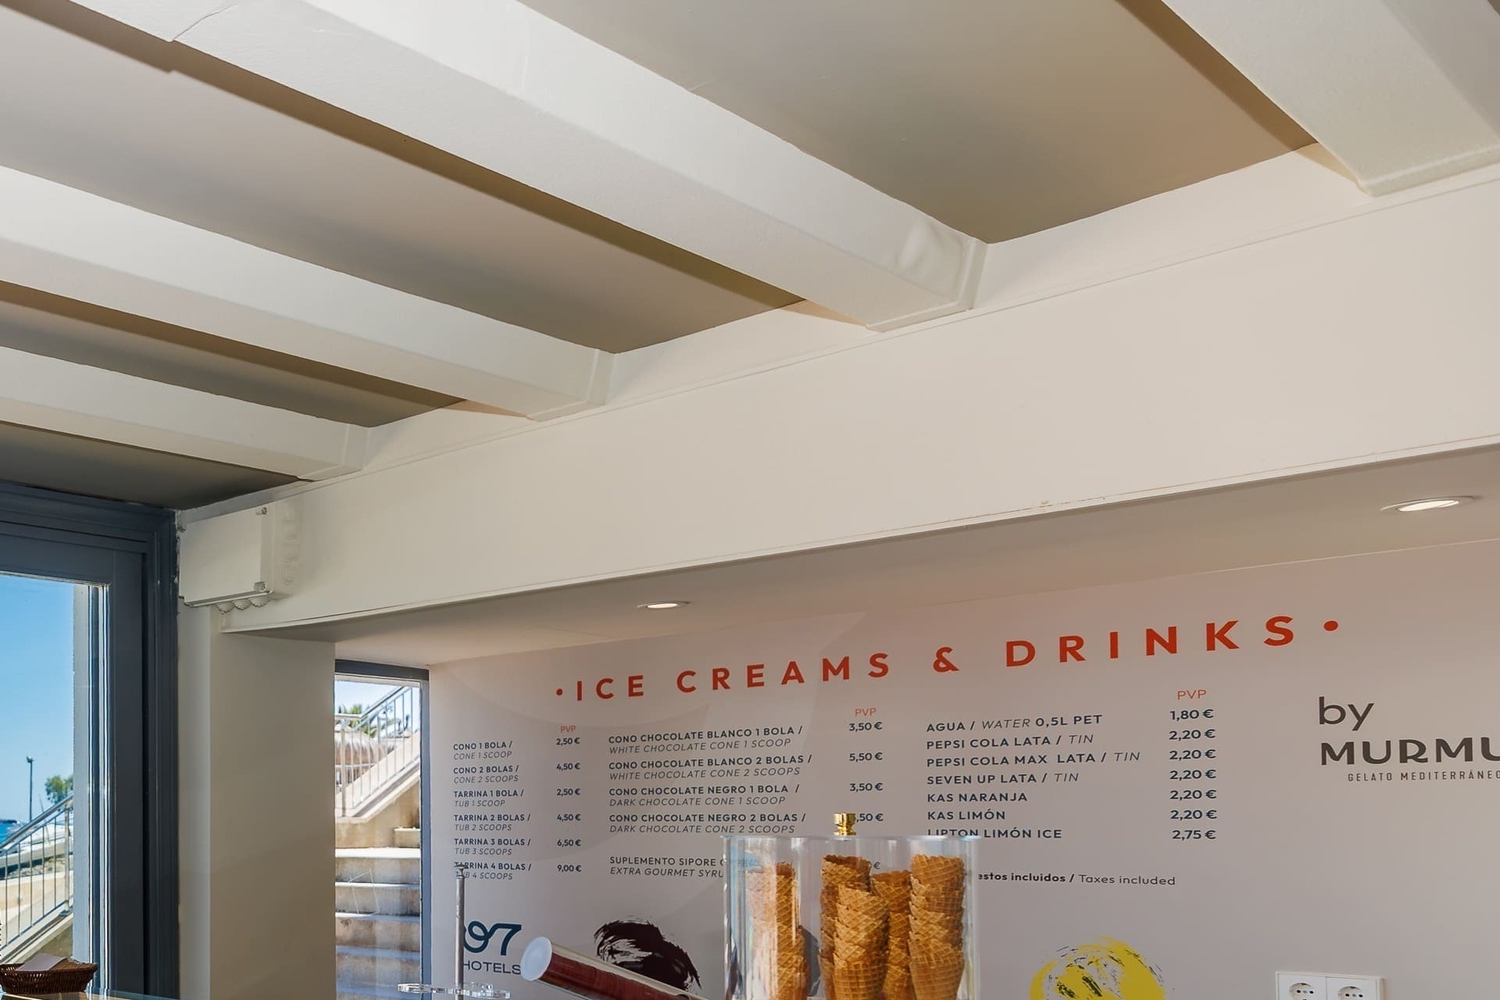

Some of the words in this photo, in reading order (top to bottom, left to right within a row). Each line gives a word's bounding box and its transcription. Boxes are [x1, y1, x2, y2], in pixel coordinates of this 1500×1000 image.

[677, 653, 888, 693] CREAMS
[933, 647, 959, 672] &
[1178, 690, 1206, 700] PVP
[855, 707, 877, 717] PVP
[1170, 710, 1199, 721] 1,80
[1319, 696, 1374, 731] by
[560, 725, 576, 733] PVP
[849, 722, 872, 732] 3,50
[927, 722, 965, 732] AGUA
[982, 719, 1030, 729] WATER
[1074, 715, 1102, 725] PET
[609, 735, 637, 744] CONO
[640, 732, 703, 742] CHOCOLATE
[707, 729, 752, 738] BLANCO
[756, 728, 759, 736] 1
[764, 727, 794, 735] BOLA
[1169, 730, 1201, 741] 2,20
[485, 741, 506, 749] BOLA
[610, 746, 640, 754] WHITE
[643, 743, 706, 753] CHOCOLATE
[710, 741, 740, 750] CONE
[751, 738, 791, 748] SCOOP
[927, 740, 964, 749] PEPSI
[970, 738, 1009, 748] COLA
[1015, 736, 1050, 746] LATA
[1069, 734, 1093, 744] TIN
[454, 752, 476, 760] CONE
[483, 751, 512, 759] SCOOP
[1170, 750, 1201, 761] 2,20
[1321, 737, 1500, 765] MURMU
[609, 762, 637, 770] CONO
[640, 759, 703, 769] CHOCOLATE
[708, 757, 752, 766] BLANCO
[766, 755, 803, 764] BOLAS
[849, 753, 872, 762] 5,50
[927, 758, 964, 767] PEPSI
[970, 757, 1009, 766] COLA
[1015, 755, 1047, 764] MAX
[1058, 754, 1095, 763] LATA
[1114, 752, 1140, 761] TIN
[486, 765, 513, 773] BOLAS
[610, 772, 640, 780] WHITE
[644, 770, 706, 779] CHOCOLATE
[710, 769, 740, 777] CONE
[744, 769, 750, 777] 2
[753, 767, 800, 776] SCOOPS
[454, 776, 476, 784] CONE
[485, 775, 518, 783] SCOOPS
[927, 775, 971, 784] SEVEN
[977, 775, 995, 783] UP
[1001, 774, 1036, 783] LATA
[1054, 773, 1078, 782] TIN
[1170, 770, 1202, 781] 2,20
[1348, 773, 1392, 781] GELATO
[609, 788, 637, 796] CONO
[641, 787, 704, 795] CHOCOLATE
[708, 786, 746, 794] NEGRO
[758, 785, 788, 793] BOLA
[850, 783, 873, 792] 3,50
[639, 798, 701, 806] CHOCOLATE
[705, 797, 735, 805] CONE
[746, 796, 785, 805] SCOOP
[928, 794, 953, 802] KAS
[959, 793, 1027, 802] NARANJA
[1170, 790, 1202, 801] 2,20
[641, 814, 704, 822] CHOCOLATE
[708, 814, 746, 822] NEGRO
[750, 814, 756, 822] 2
[928, 811, 953, 820] KAS
[959, 809, 1005, 820] LIMÓN
[1171, 810, 1202, 821] 2,20
[610, 825, 636, 833] DARK
[639, 825, 701, 833] CHOCOLATE
[705, 825, 735, 833] CONE
[738, 825, 745, 833] 2
[748, 825, 795, 833] SCOOPS
[927, 828, 979, 838] LIPTON
[984, 827, 1031, 838] LIMÓN
[1038, 830, 1061, 838] ICE
[1172, 830, 1201, 841] 2,75
[610, 856, 675, 865] SUPLEMENTO
[679, 858, 716, 866] SIPORE
[480, 872, 513, 880] SCOOPS
[610, 867, 641, 875] EXTRA
[644, 868, 695, 877] GOURMET
[1011, 873, 1065, 882] incluidos
[1079, 874, 1115, 883] Taxes
[1119, 876, 1175, 885] included
[464, 961, 521, 975] HOTELS
